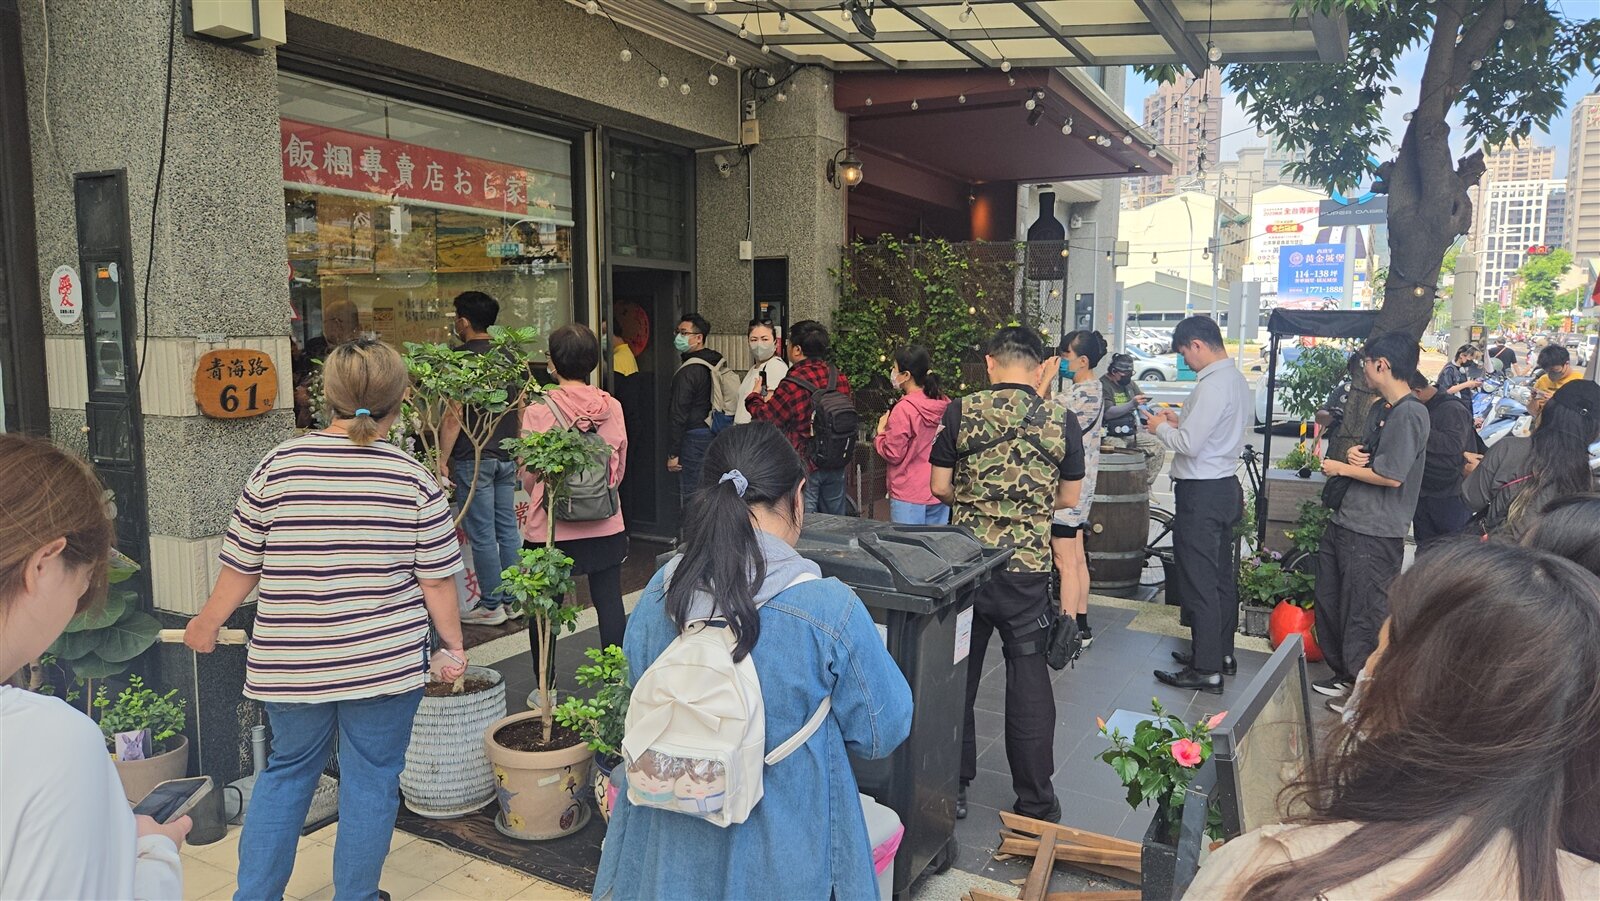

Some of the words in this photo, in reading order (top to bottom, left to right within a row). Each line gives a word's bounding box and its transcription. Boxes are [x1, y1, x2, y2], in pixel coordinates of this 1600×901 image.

[206, 357, 269, 381] 青海路
[219, 382, 259, 413] 61
